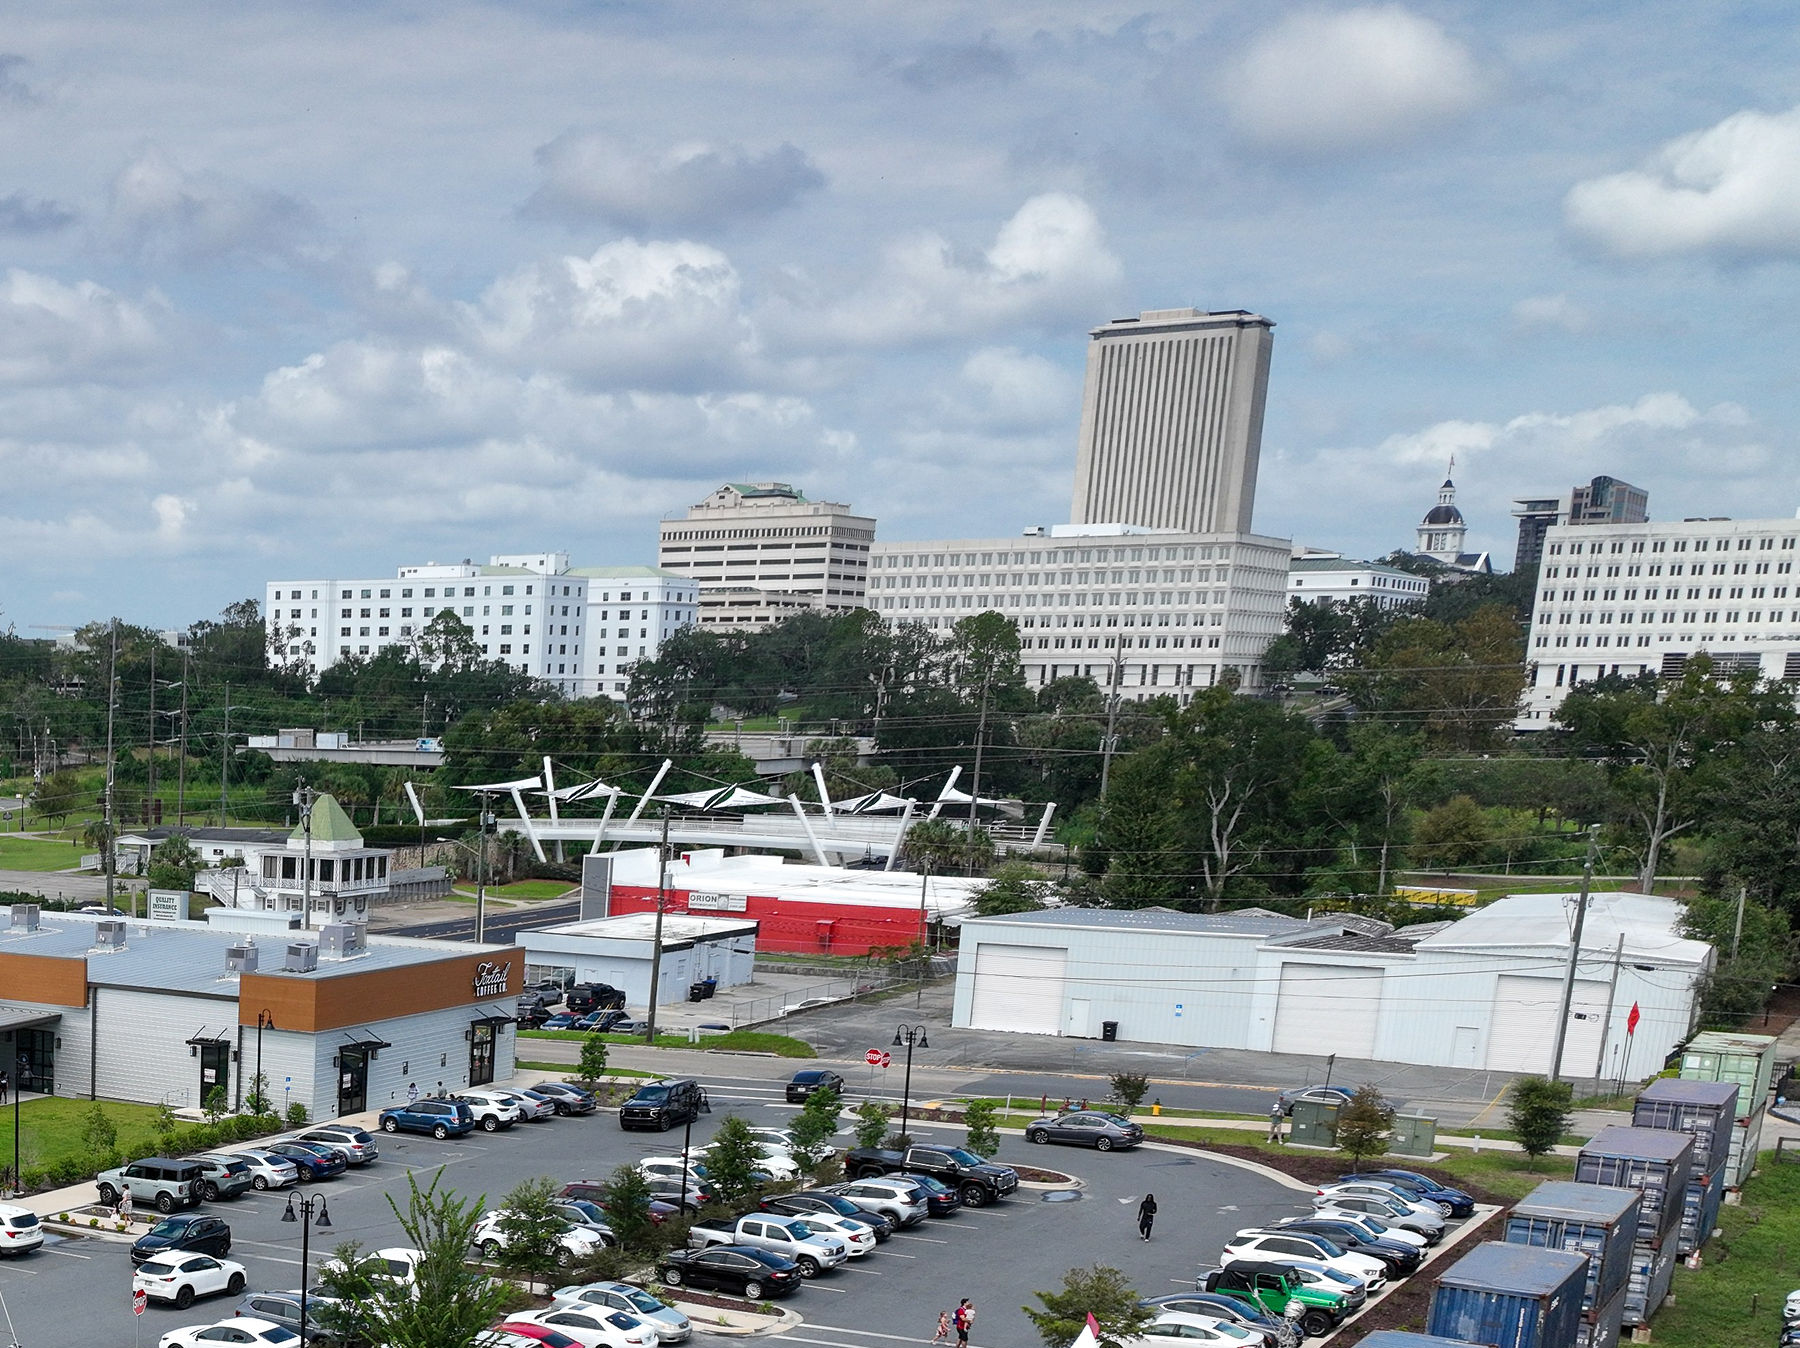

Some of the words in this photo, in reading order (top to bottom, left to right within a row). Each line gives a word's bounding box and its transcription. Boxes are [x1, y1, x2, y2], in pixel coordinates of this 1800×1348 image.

[155, 896, 175, 904] QUALITY
[690, 894, 717, 902] ORION
[152, 903, 178, 911] INSURANCE
[476, 984, 498, 997] COFFEE
[865, 1053, 881, 1061] STOP
